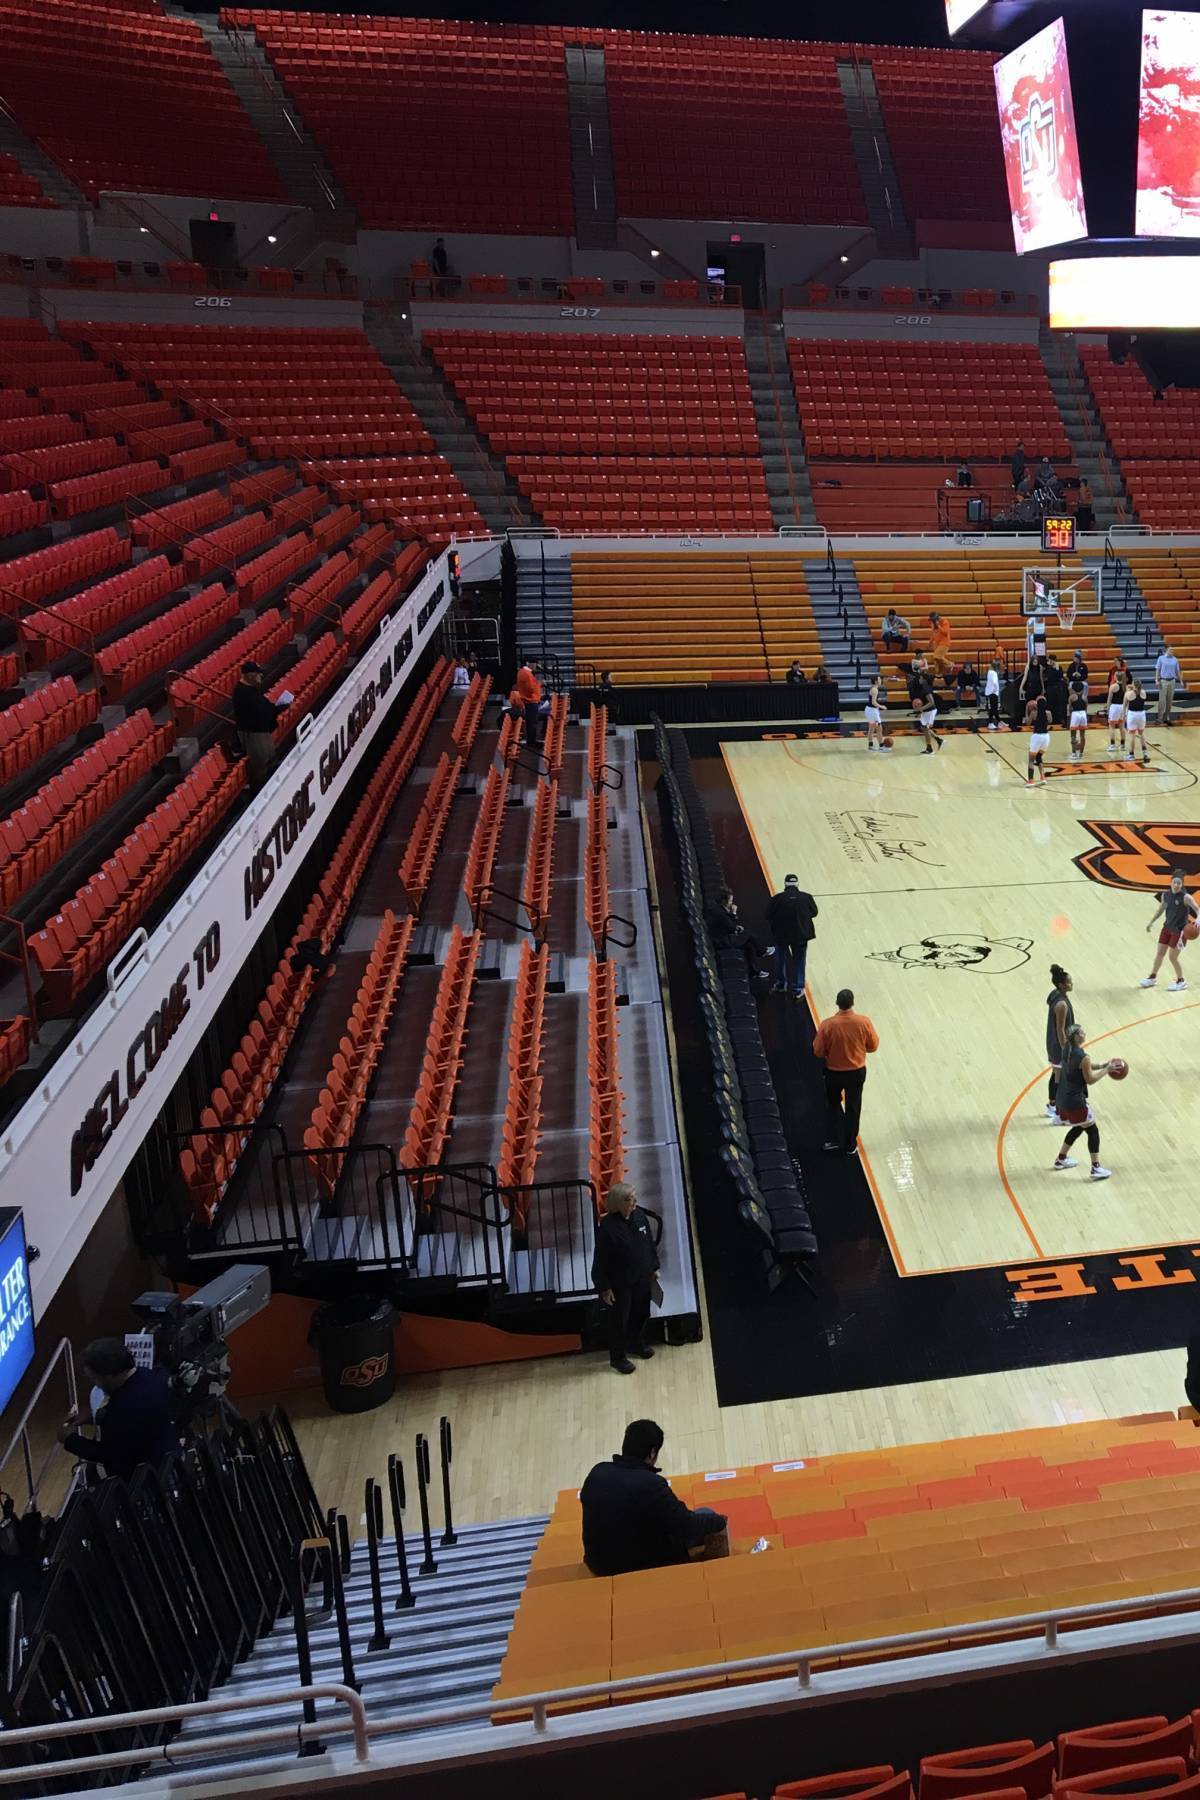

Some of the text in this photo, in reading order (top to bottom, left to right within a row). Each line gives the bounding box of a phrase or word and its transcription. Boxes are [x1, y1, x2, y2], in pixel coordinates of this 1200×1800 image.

[194, 296, 232, 307] 206
[560, 307, 600, 317] 207
[1046, 520, 1072, 530] 59:22
[1050, 530, 1069, 546] 30
[71, 963, 190, 1196] WELCOME
[193, 921, 220, 990] TO
[244, 769, 315, 920] HISTORIC
[340, 1352, 389, 1387] OSU
